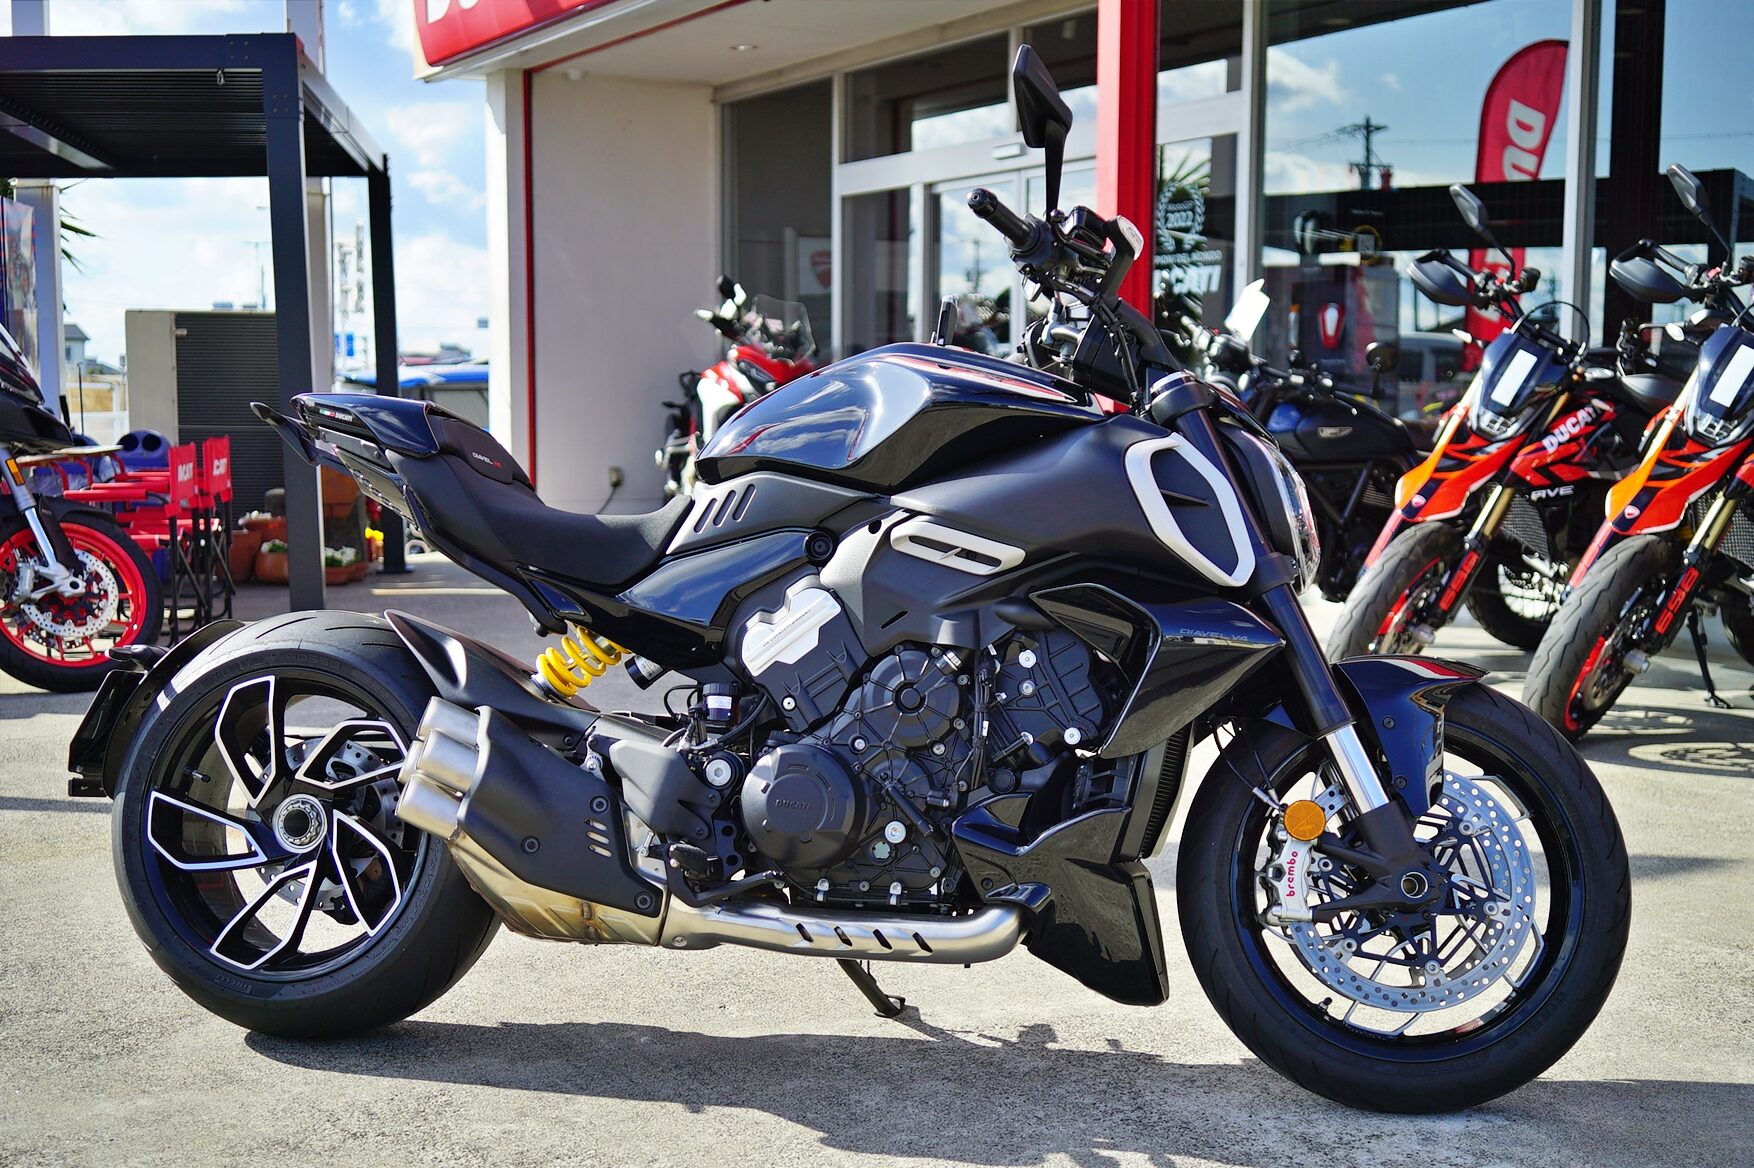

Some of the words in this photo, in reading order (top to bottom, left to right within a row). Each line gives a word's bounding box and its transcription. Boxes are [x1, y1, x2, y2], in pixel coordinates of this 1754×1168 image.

[1165, 210, 1194, 229] 2022
[1179, 628, 1229, 640] DIAVEL
[774, 799, 811, 812] DUCATI
[1285, 850, 1299, 898] brembo
